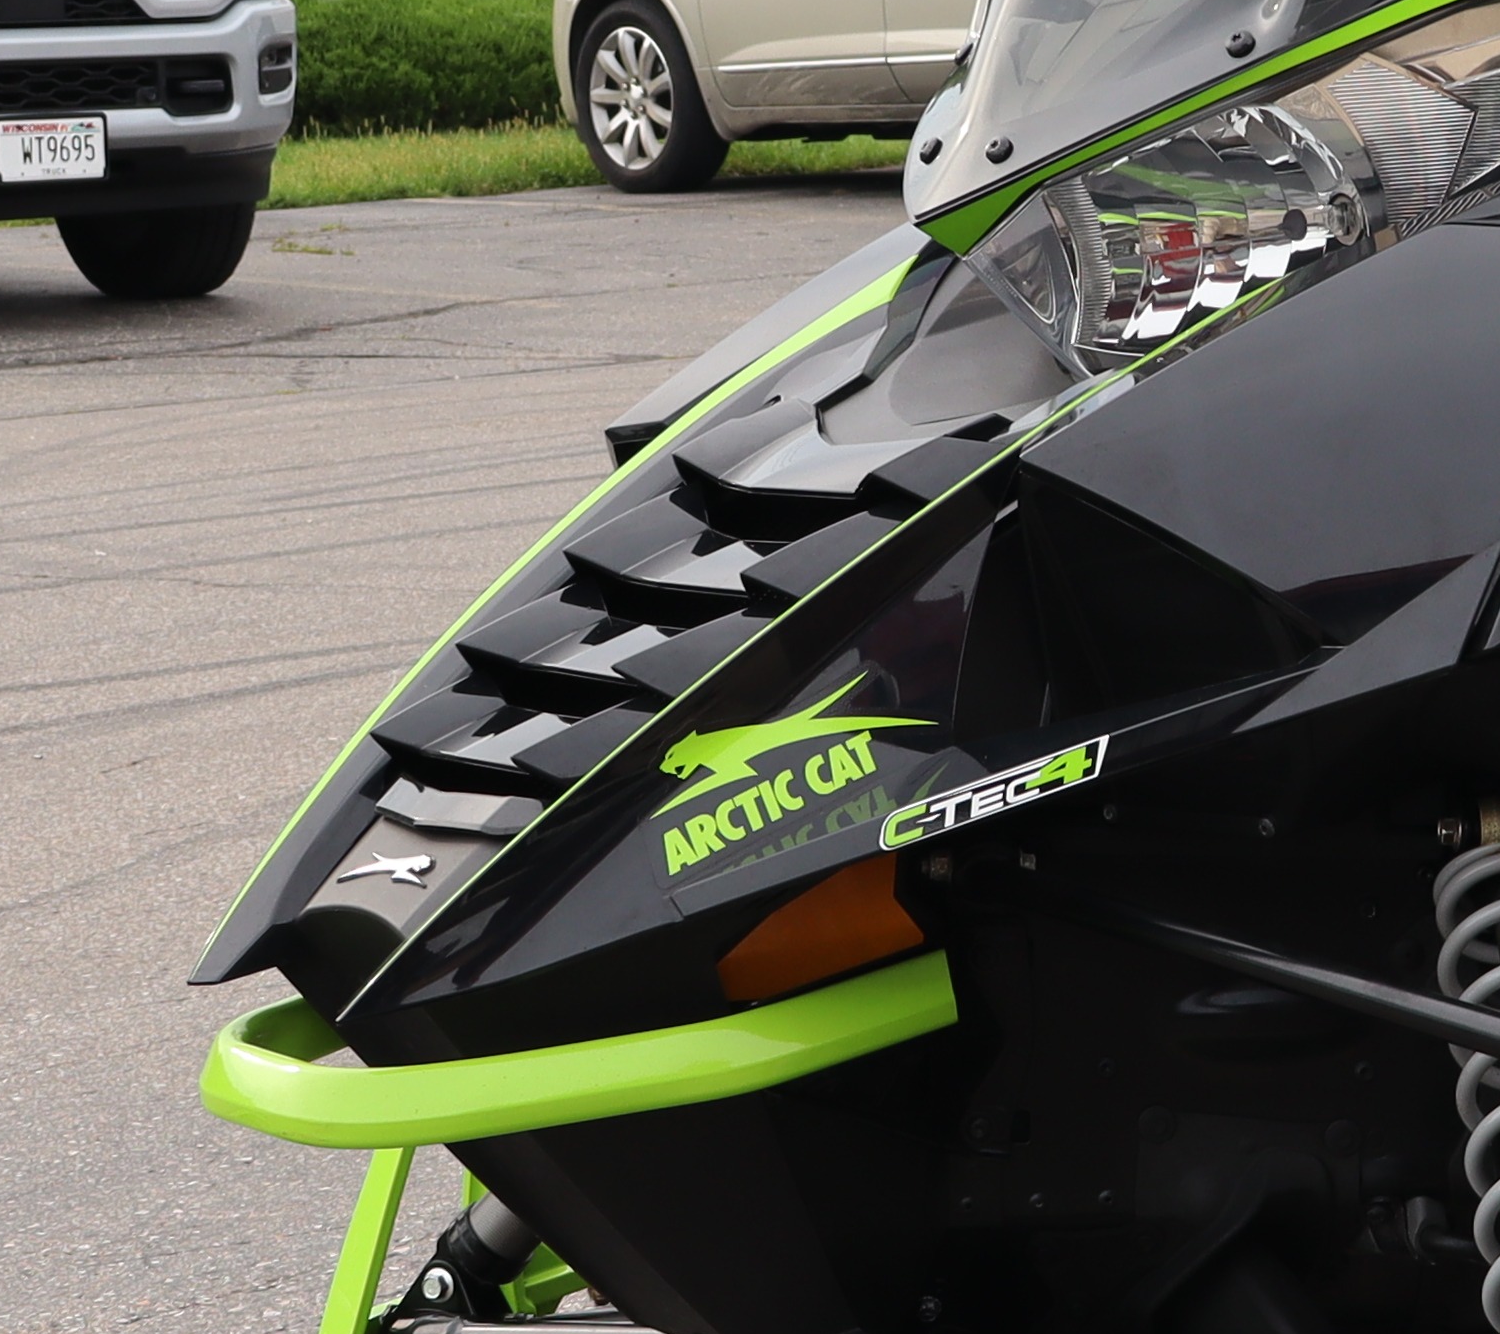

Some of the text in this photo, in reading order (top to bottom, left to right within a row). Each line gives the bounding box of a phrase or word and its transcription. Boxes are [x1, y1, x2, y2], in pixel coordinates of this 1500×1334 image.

[21, 134, 95, 165] WT9695
[662, 769, 805, 876] ARCTIC
[805, 731, 879, 796] CAT
[884, 746, 1093, 848] C-TEC4
